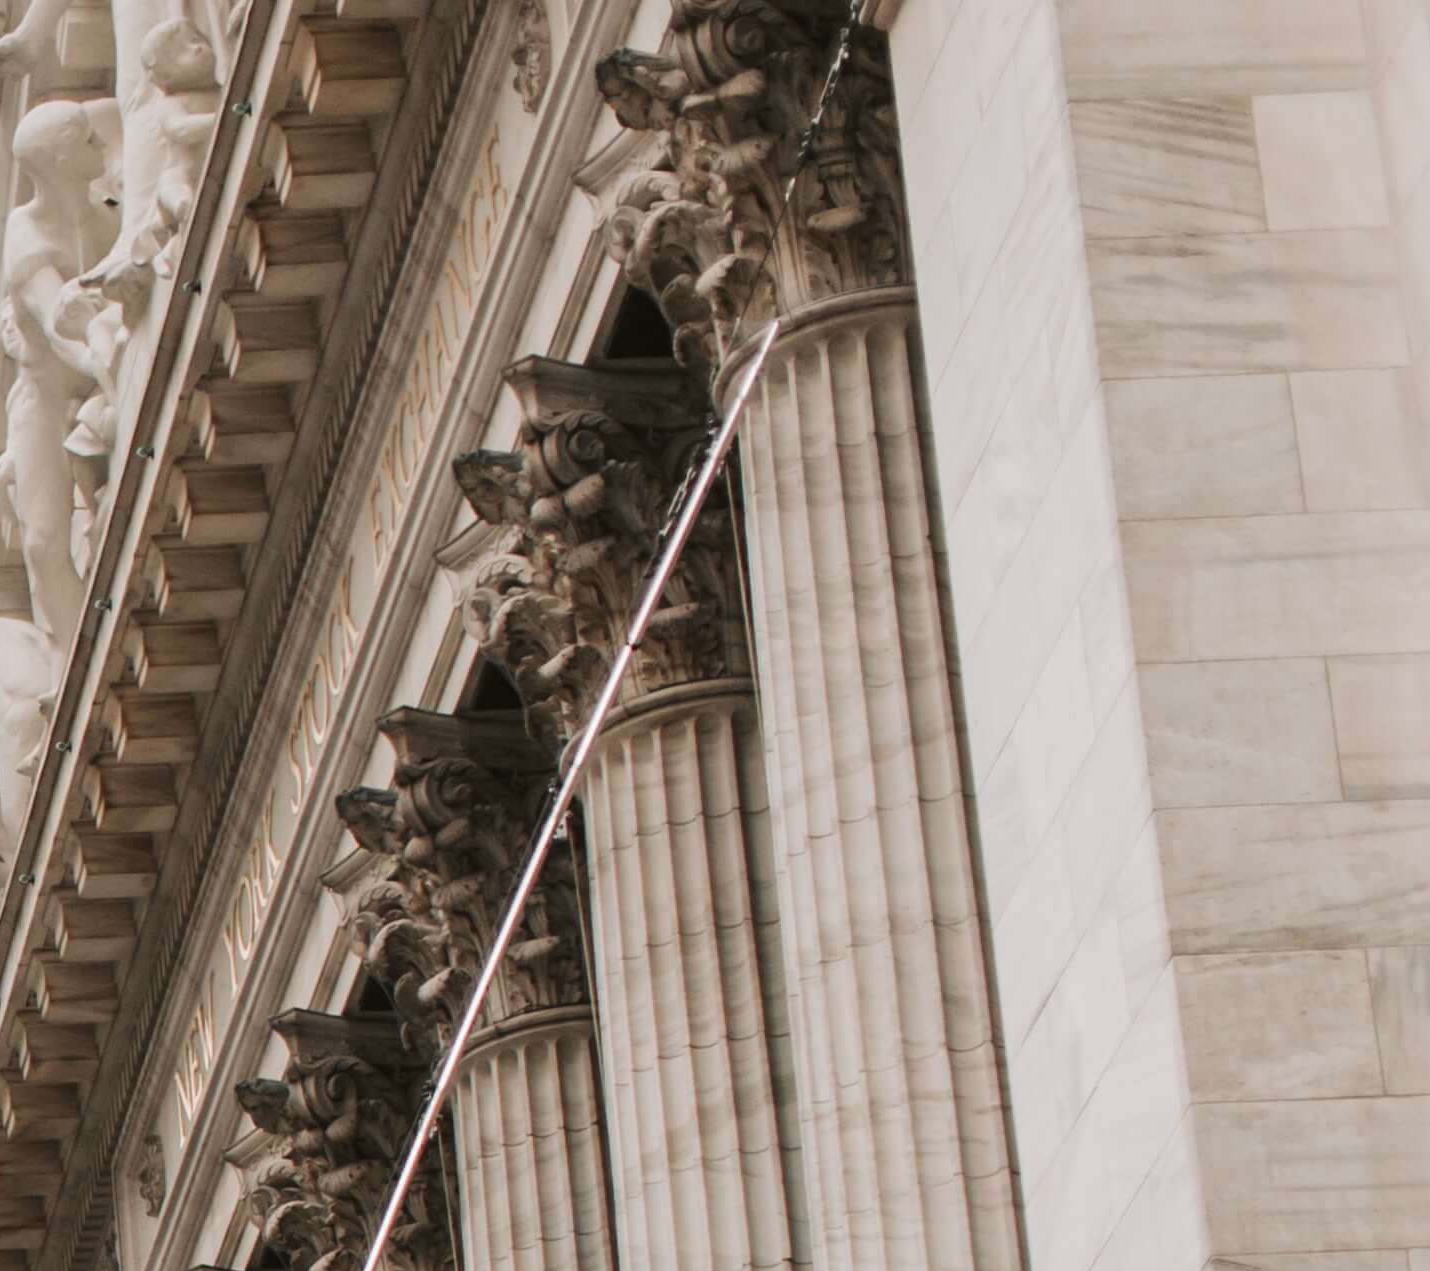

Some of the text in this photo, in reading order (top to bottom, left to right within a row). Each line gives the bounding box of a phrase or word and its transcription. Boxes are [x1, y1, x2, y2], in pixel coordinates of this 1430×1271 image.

[174, 122, 507, 1150] NEW YORK STOCK EXCHANGE
